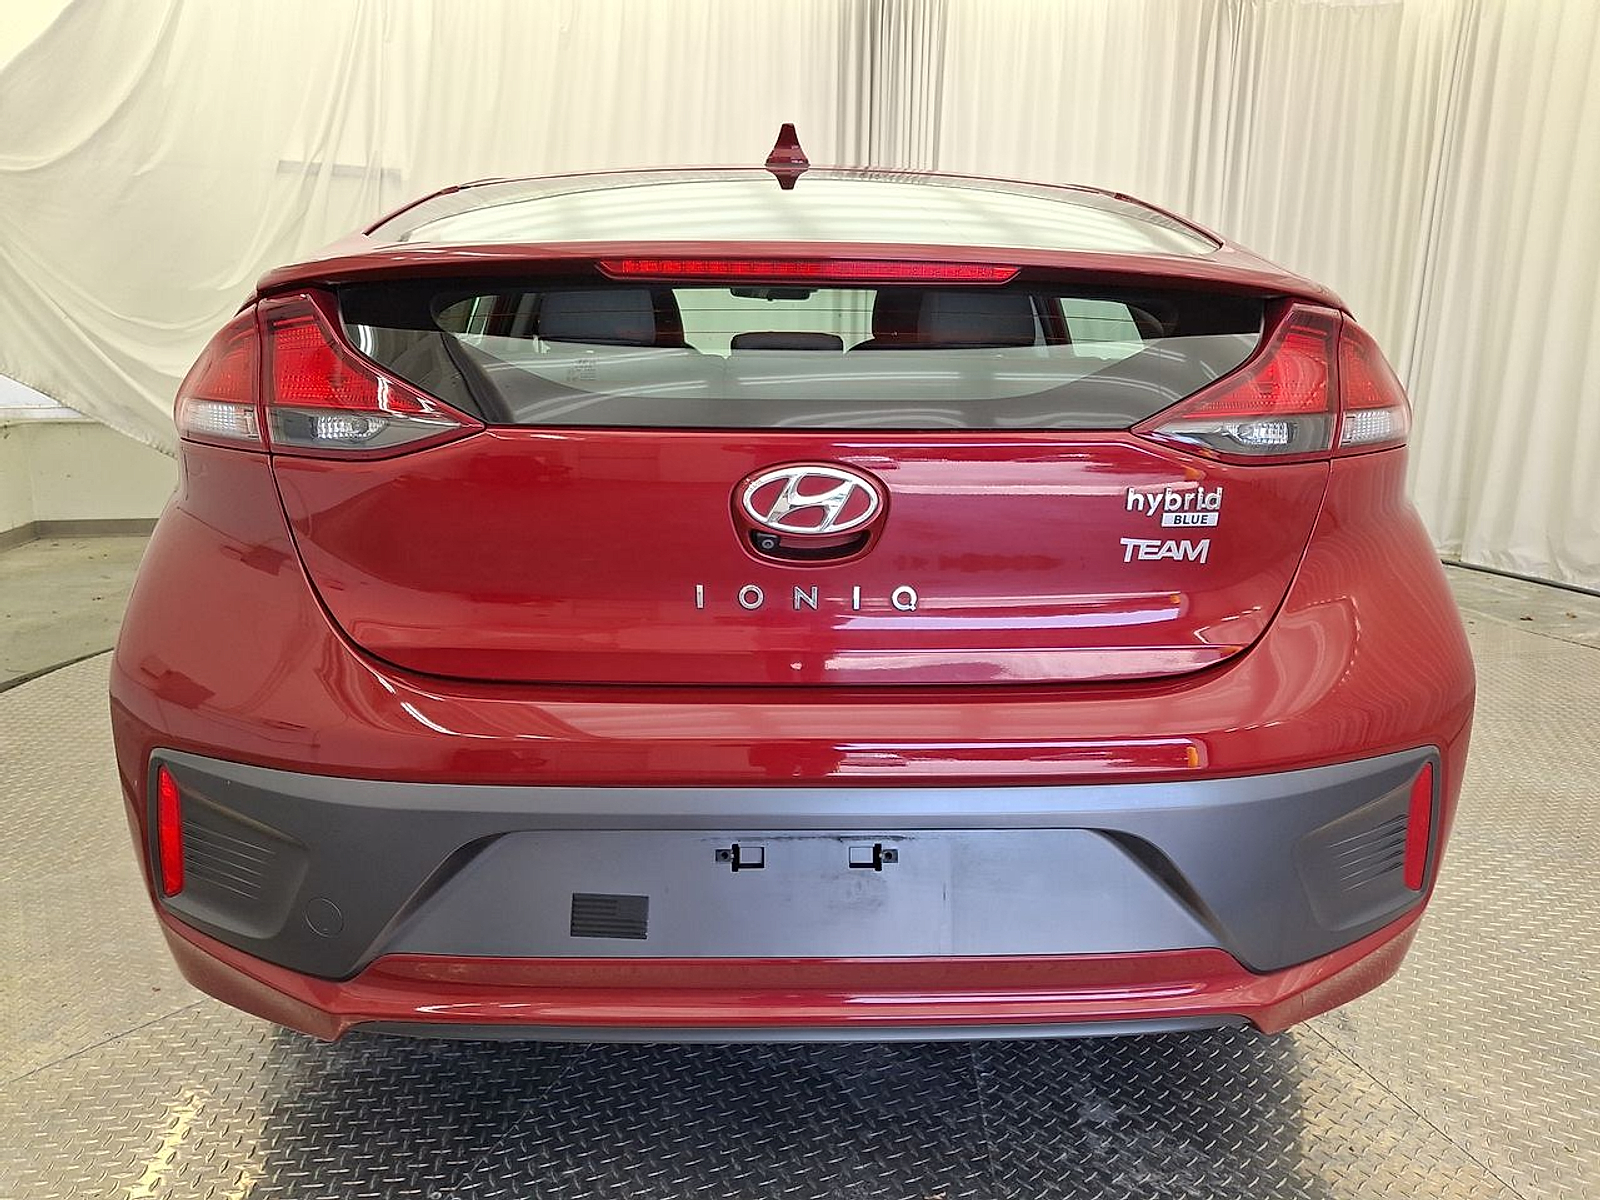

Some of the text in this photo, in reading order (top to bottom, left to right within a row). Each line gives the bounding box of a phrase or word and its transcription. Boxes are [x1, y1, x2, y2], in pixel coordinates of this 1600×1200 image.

[1126, 487, 1223, 516] hybrid
[1173, 514, 1209, 525] BLUE
[1120, 537, 1210, 564] TEAM
[695, 584, 918, 611] IONIQ
